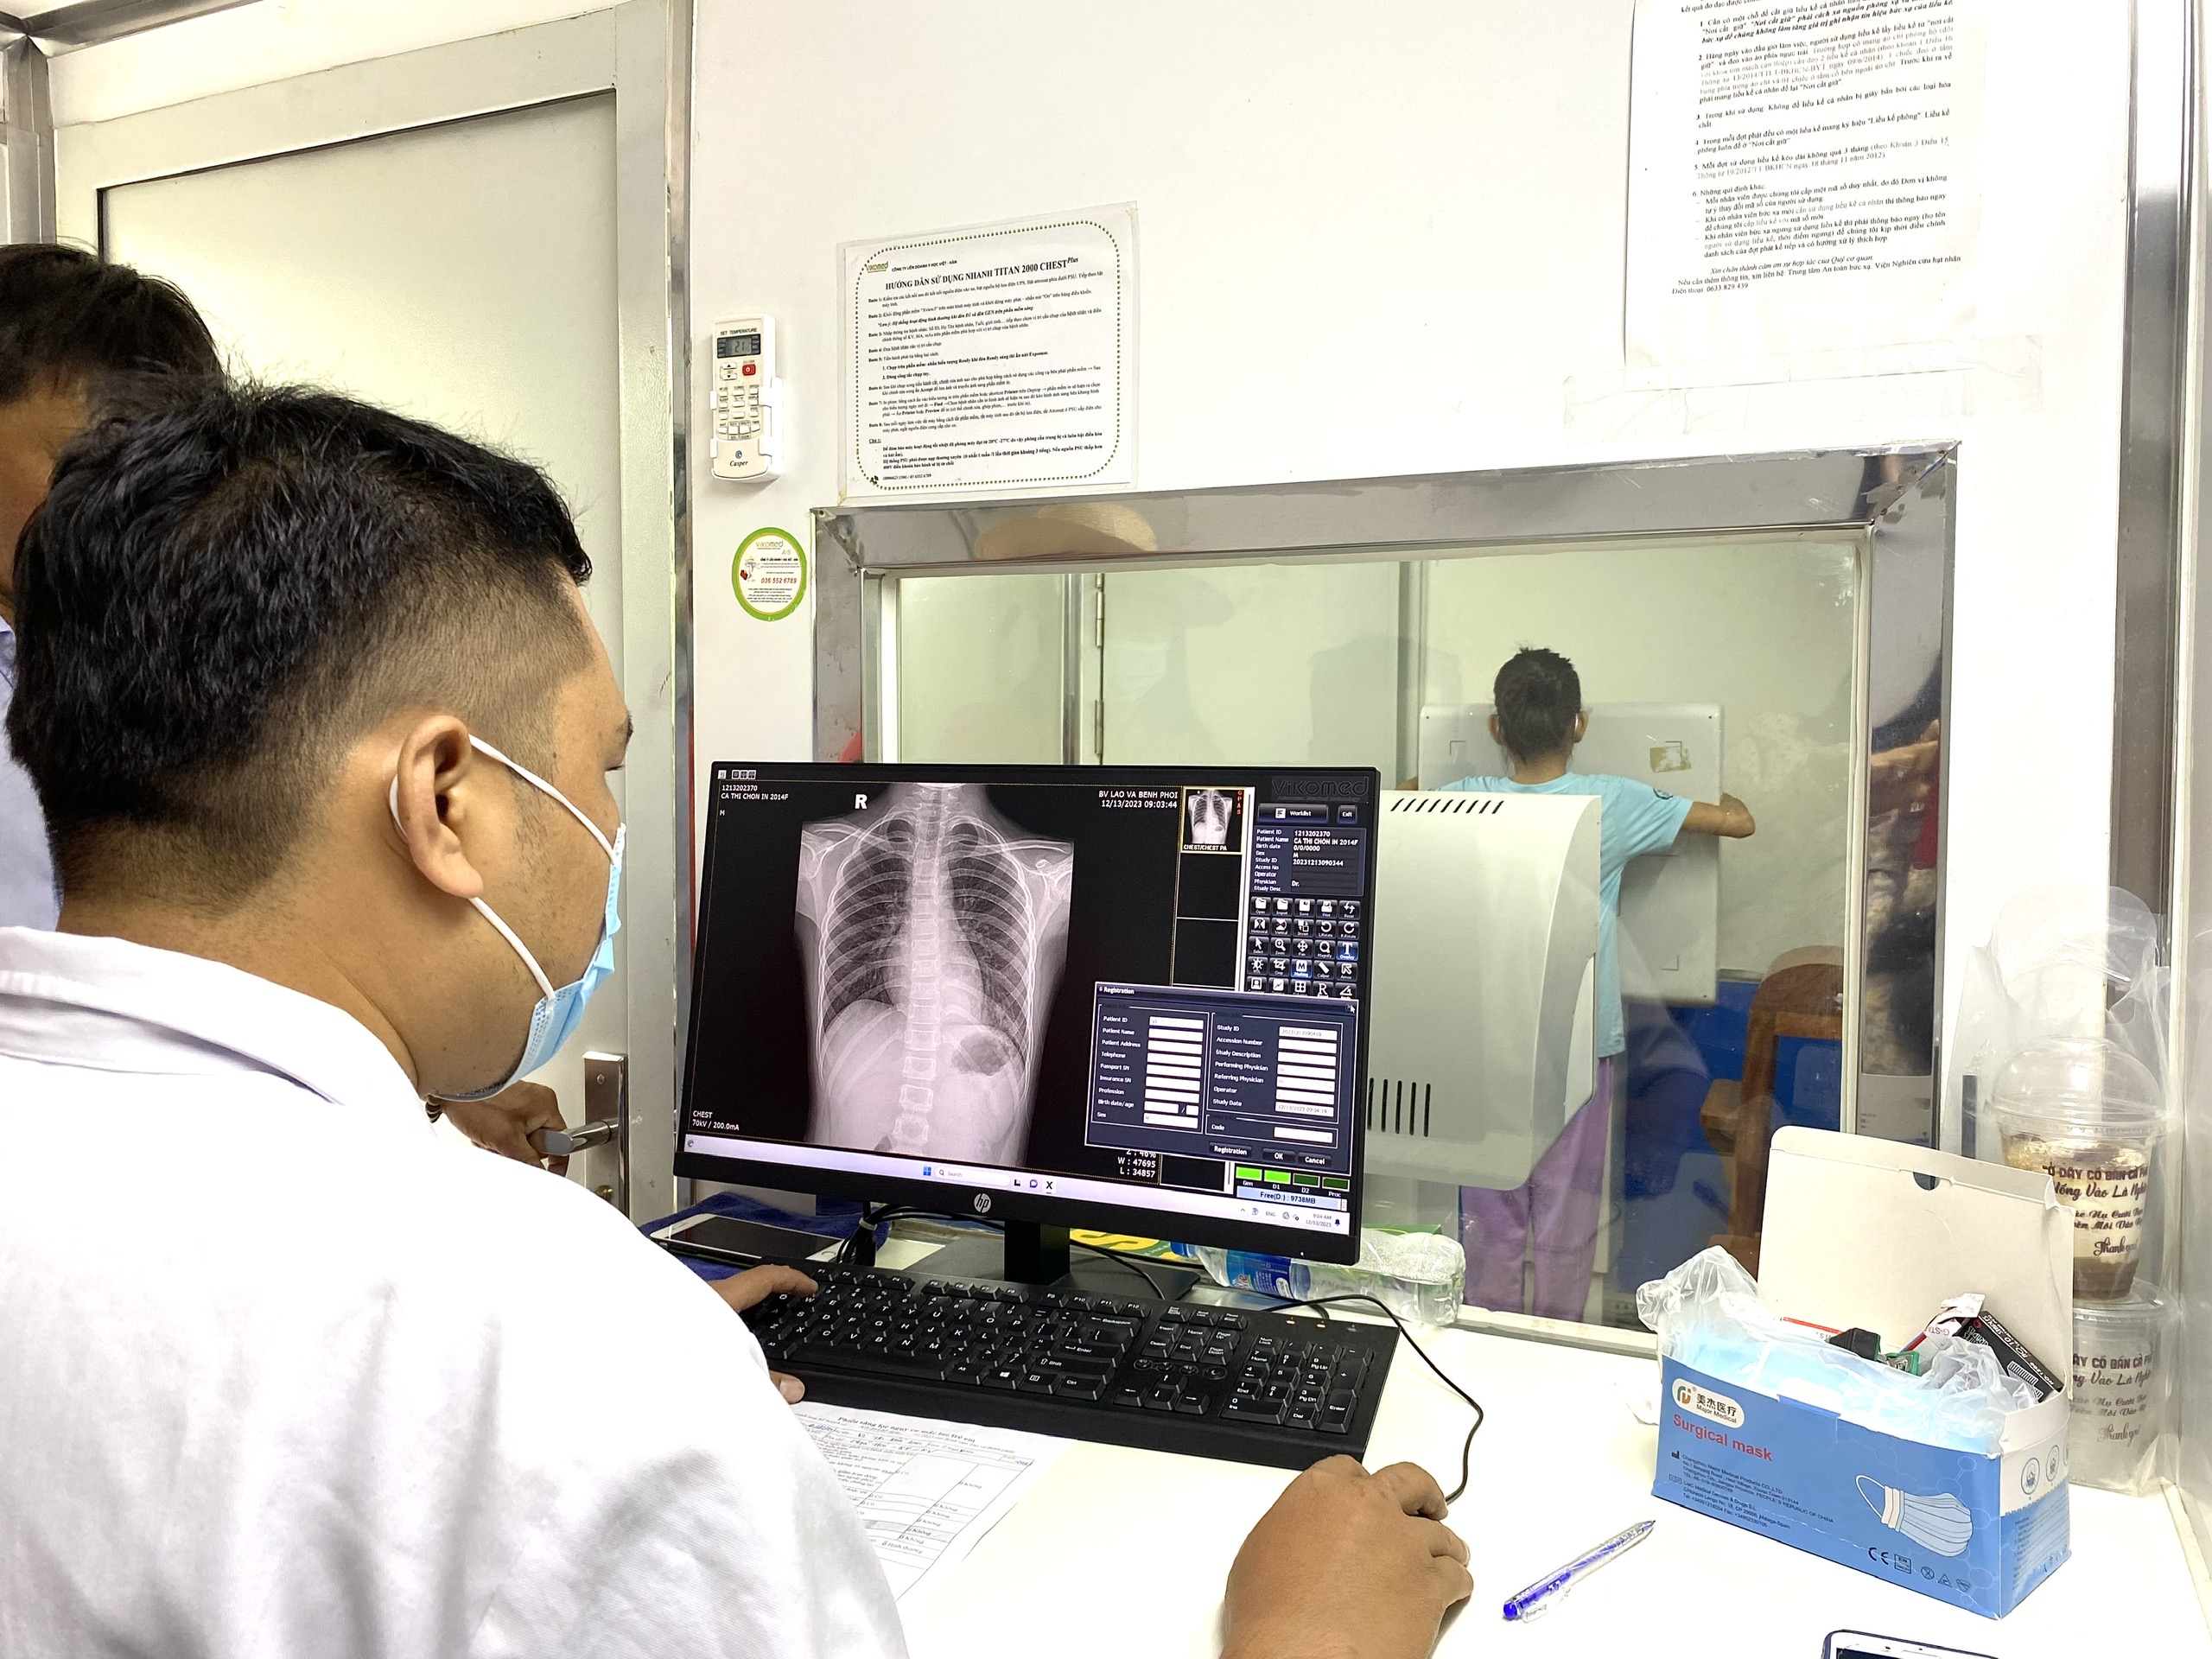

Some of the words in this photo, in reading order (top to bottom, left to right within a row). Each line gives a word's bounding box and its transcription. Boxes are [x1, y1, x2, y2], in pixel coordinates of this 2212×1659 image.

[886, 280, 912, 290] HƯỚNG
[914, 277, 930, 287] DẪN
[931, 275, 942, 284] SỬ
[943, 273, 964, 284] DỤNG
[965, 270, 993, 280] NHANH
[995, 265, 1020, 276] TITAN
[1021, 263, 1039, 273] 2000
[1040, 259, 1068, 270] CHEST
[735, 341, 745, 353] 21
[855, 794, 867, 809] R
[1103, 986, 1135, 995] Registration
[1215, 1061, 1243, 1070] Performing
[1214, 1073, 1239, 1082] Referring
[713, 1122, 739, 1130] 200.0mA
[1214, 1146, 1247, 1155] Registration
[1133, 1158, 1156, 1167] 47695
[1132, 1168, 1155, 1178] 34857
[2087, 1167, 2102, 1180] CÓ
[2086, 1182, 2109, 1198] Vào
[2112, 1185, 2128, 1198] Là
[1291, 1195, 1316, 1205] 9738MB
[2092, 1355, 2107, 1369] CÓ
[2111, 1356, 2130, 1370] BÁN
[2091, 1370, 2113, 1385] Vào
[2116, 1374, 2133, 1385] Là
[1696, 1393, 1737, 1417] 美杰医疗
[1696, 1404, 1713, 1415] Major
[1713, 1411, 1737, 1424] Medical
[1674, 1414, 1728, 1446] Surgical
[1732, 1440, 1773, 1462] mask
